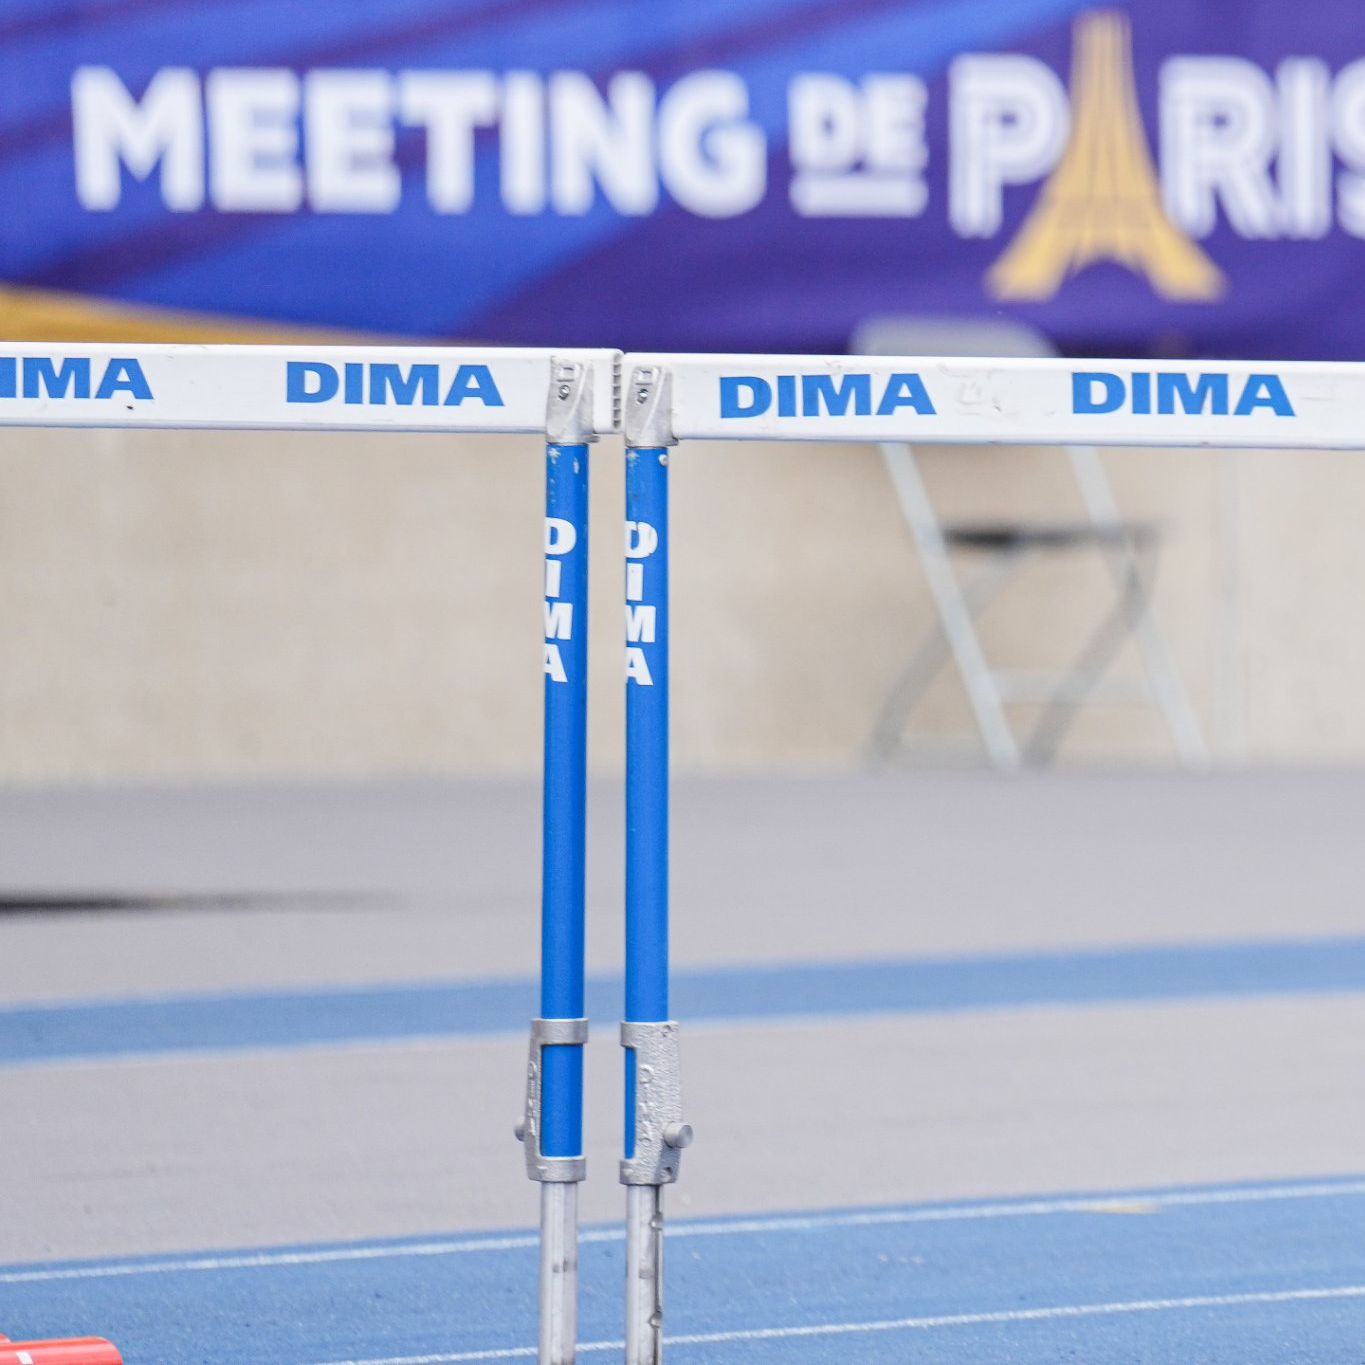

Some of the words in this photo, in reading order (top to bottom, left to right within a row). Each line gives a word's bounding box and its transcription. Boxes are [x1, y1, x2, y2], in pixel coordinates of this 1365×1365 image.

[72, 66, 768, 218] MEETING
[788, 74, 928, 169] DE
[286, 361, 505, 407] DIMA
[719, 373, 937, 419] DIMA
[1072, 371, 1296, 417] DIMA
[544, 517, 577, 683] DIMA
[624, 520, 659, 686] DIMA
